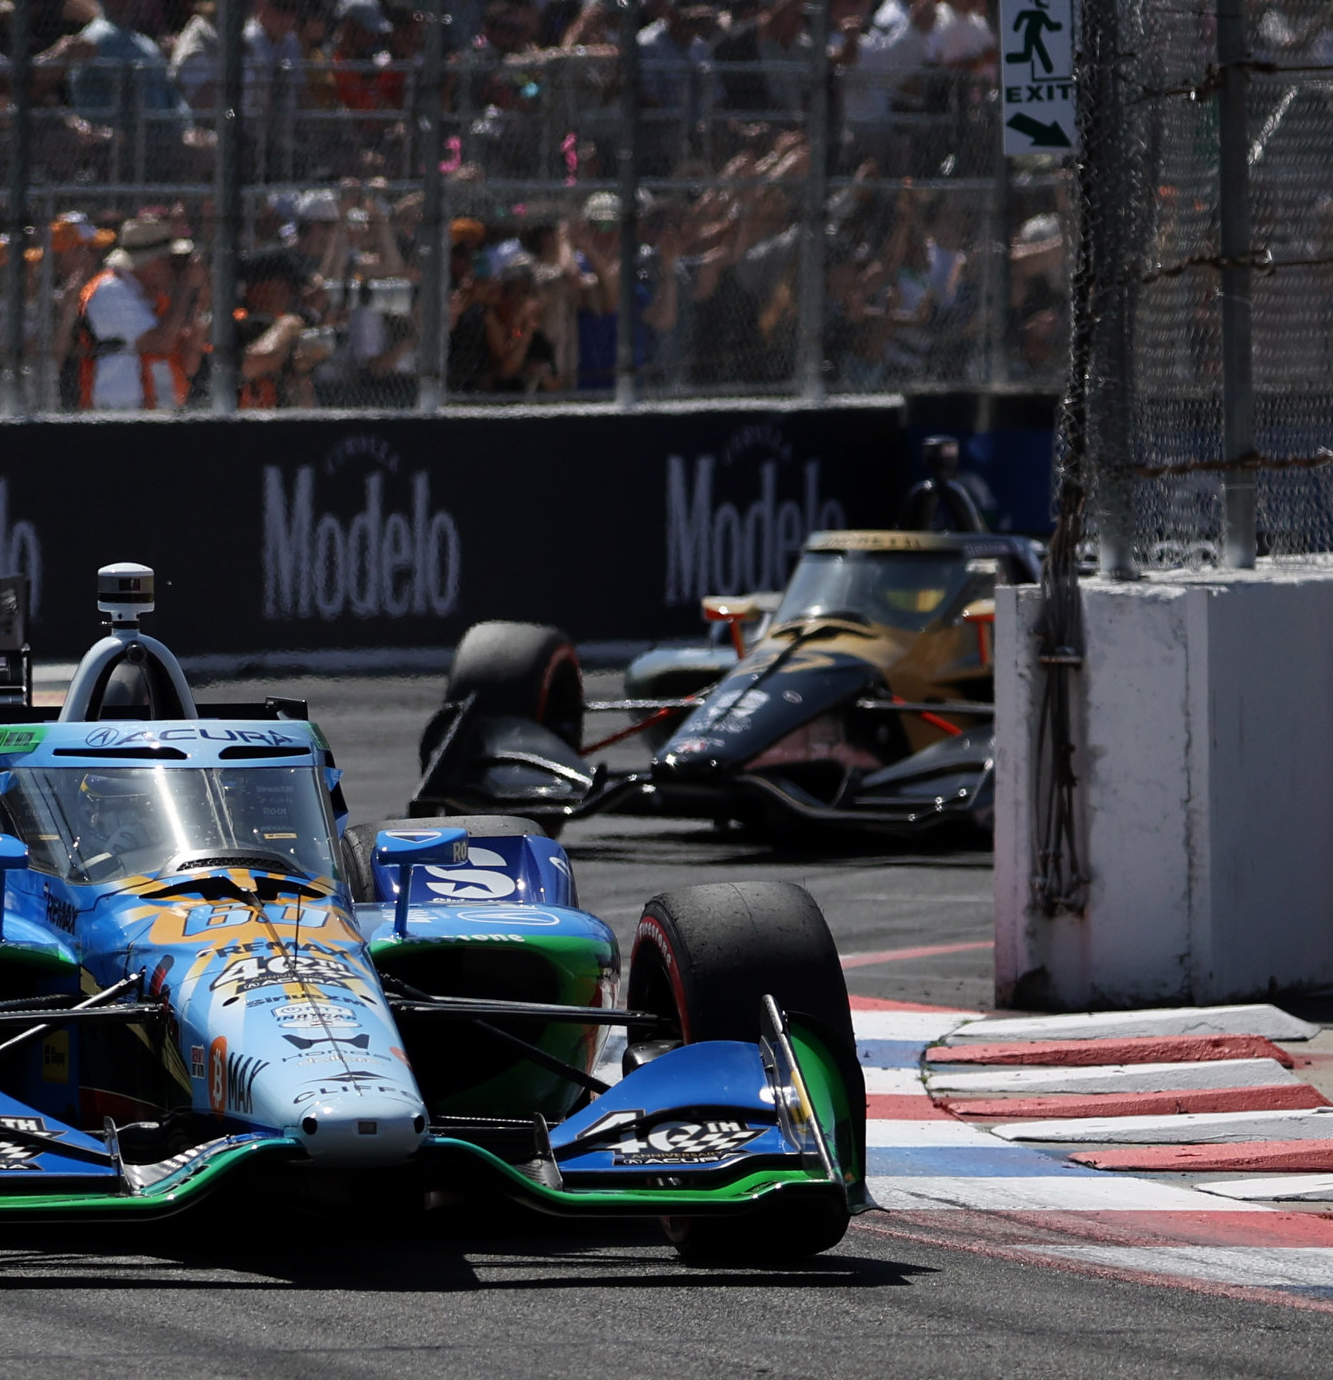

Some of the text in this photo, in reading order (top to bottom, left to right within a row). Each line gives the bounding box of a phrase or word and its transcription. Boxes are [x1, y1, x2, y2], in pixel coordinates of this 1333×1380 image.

[1006, 84, 1073, 103] EXIT
[260, 464, 462, 618] Modelo
[115, 728, 293, 748] ACURA
[182, 902, 331, 937] 60
[245, 993, 366, 1007] SiriusXM
[293, 1085, 424, 1105] CLIFFS
[645, 1152, 741, 1165] ACURA
